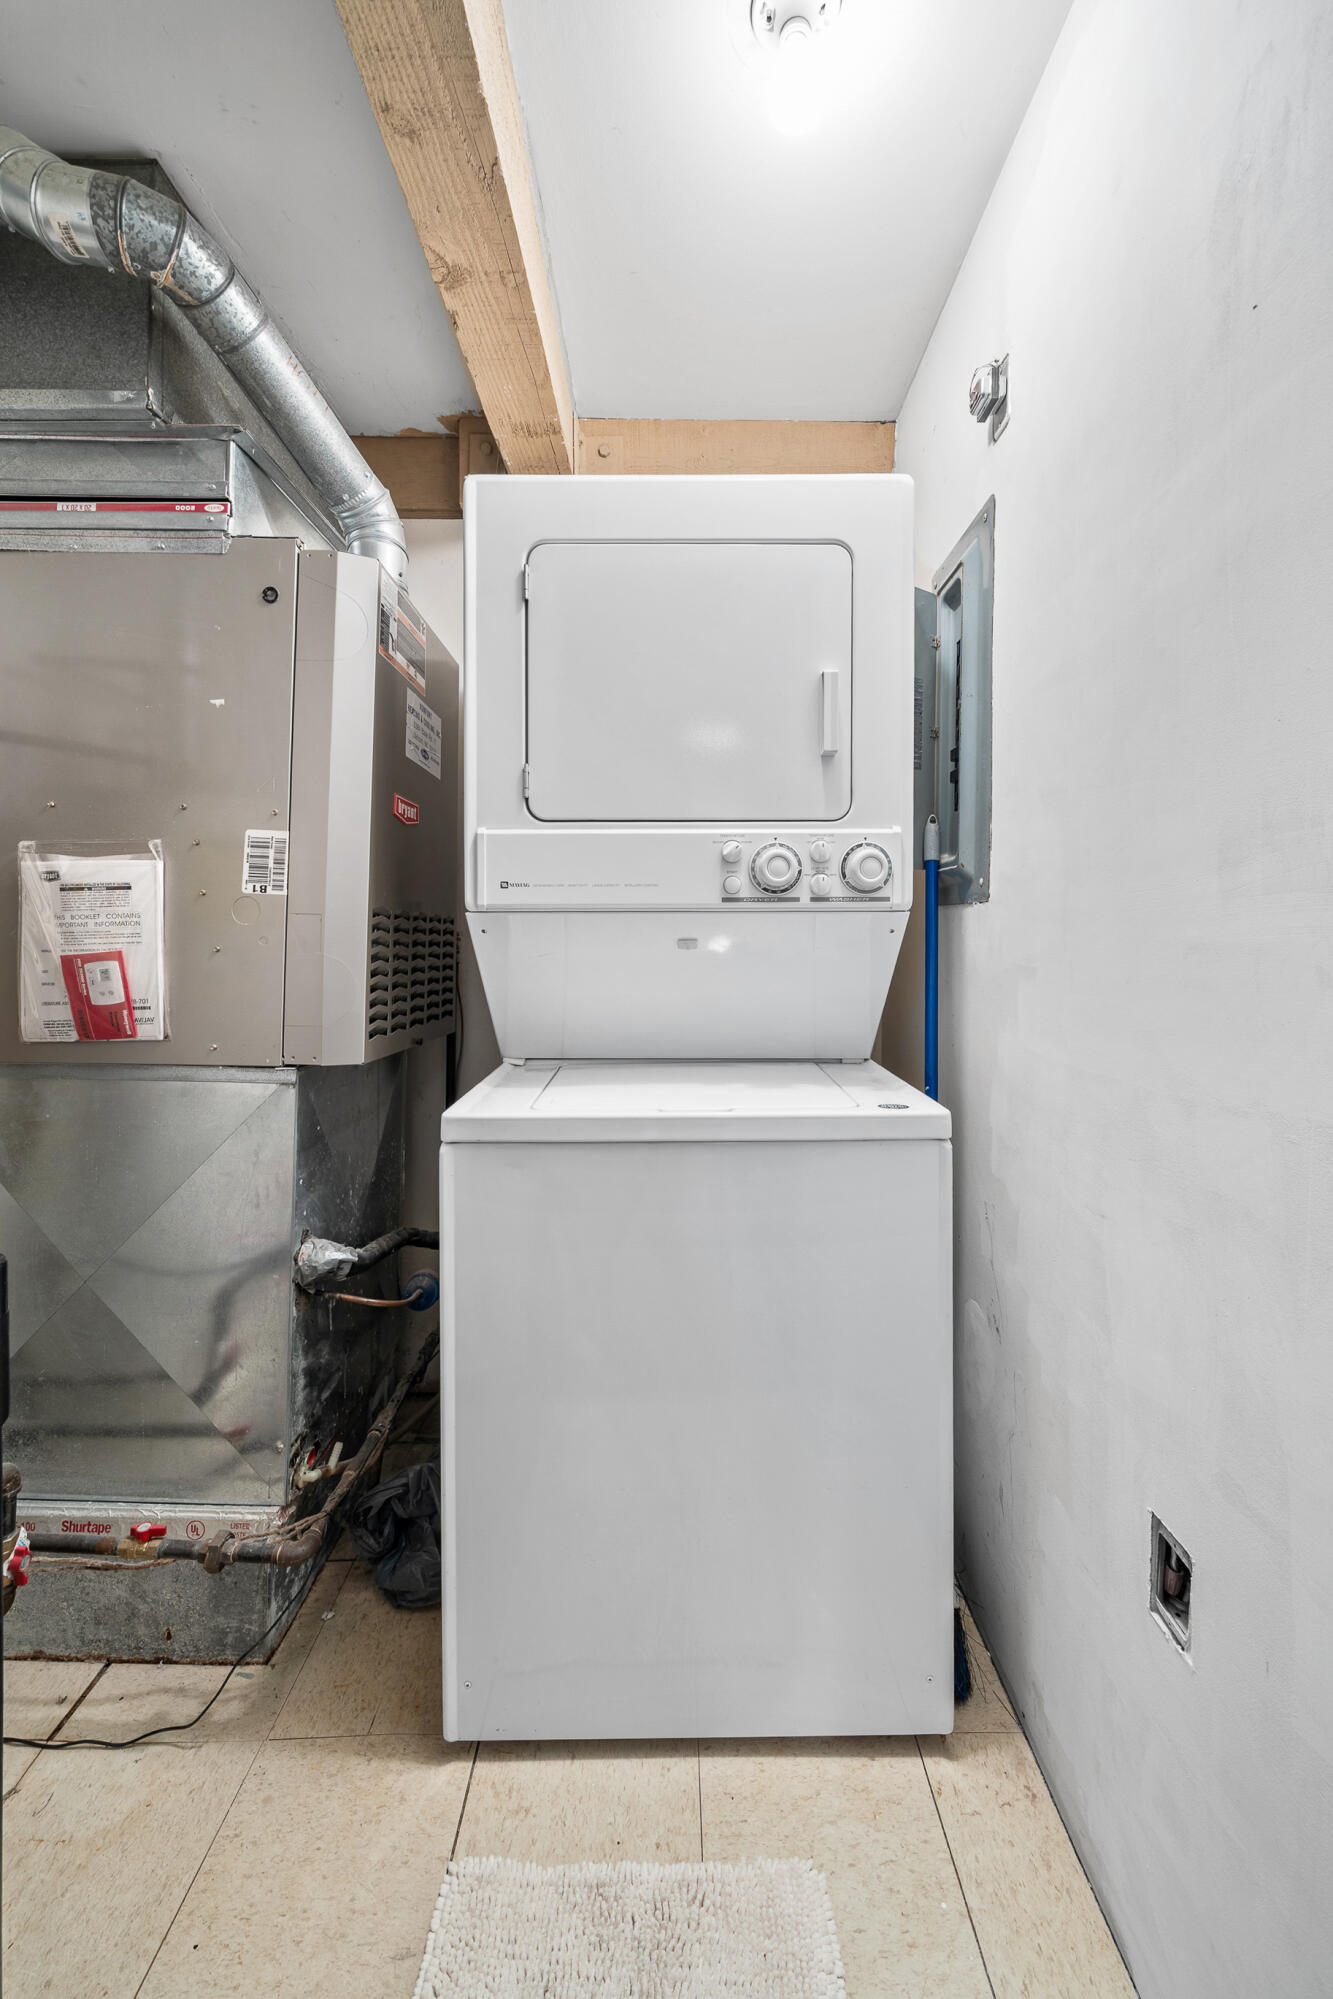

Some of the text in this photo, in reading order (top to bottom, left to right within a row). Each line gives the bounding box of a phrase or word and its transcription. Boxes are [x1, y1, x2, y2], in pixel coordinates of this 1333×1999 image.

[398, 799, 417, 820] bryant
[252, 884, 267, 893] B1
[105, 912, 141, 920] CONTAINS
[93, 920, 141, 928] INFORMATION
[61, 1520, 112, 1535] Shurtape
[229, 1522, 251, 1530] LISTED
